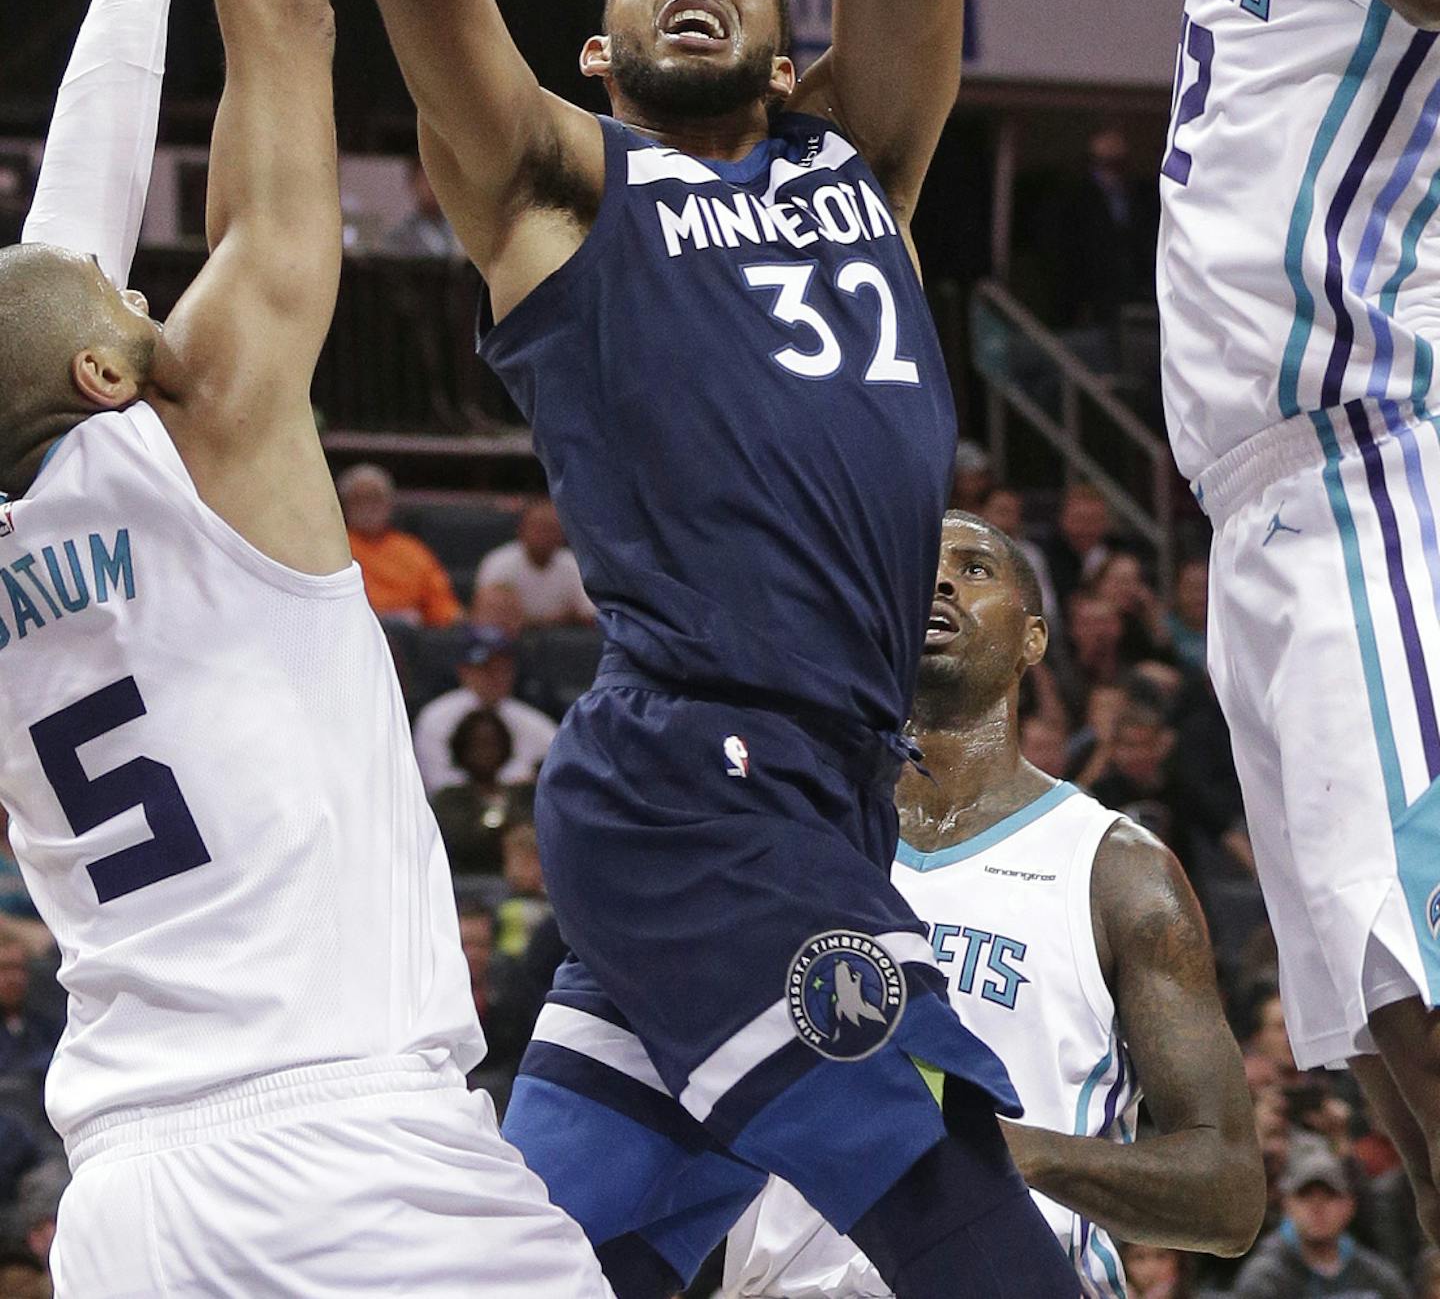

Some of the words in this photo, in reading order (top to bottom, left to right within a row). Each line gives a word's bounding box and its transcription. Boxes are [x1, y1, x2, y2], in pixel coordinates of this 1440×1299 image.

[738, 259, 921, 386] 32
[0, 528, 136, 650] ATUM
[28, 675, 212, 906] 5
[790, 956, 822, 1045] MINNESOTA
[811, 936, 900, 1006] TIMBERWOLVES
